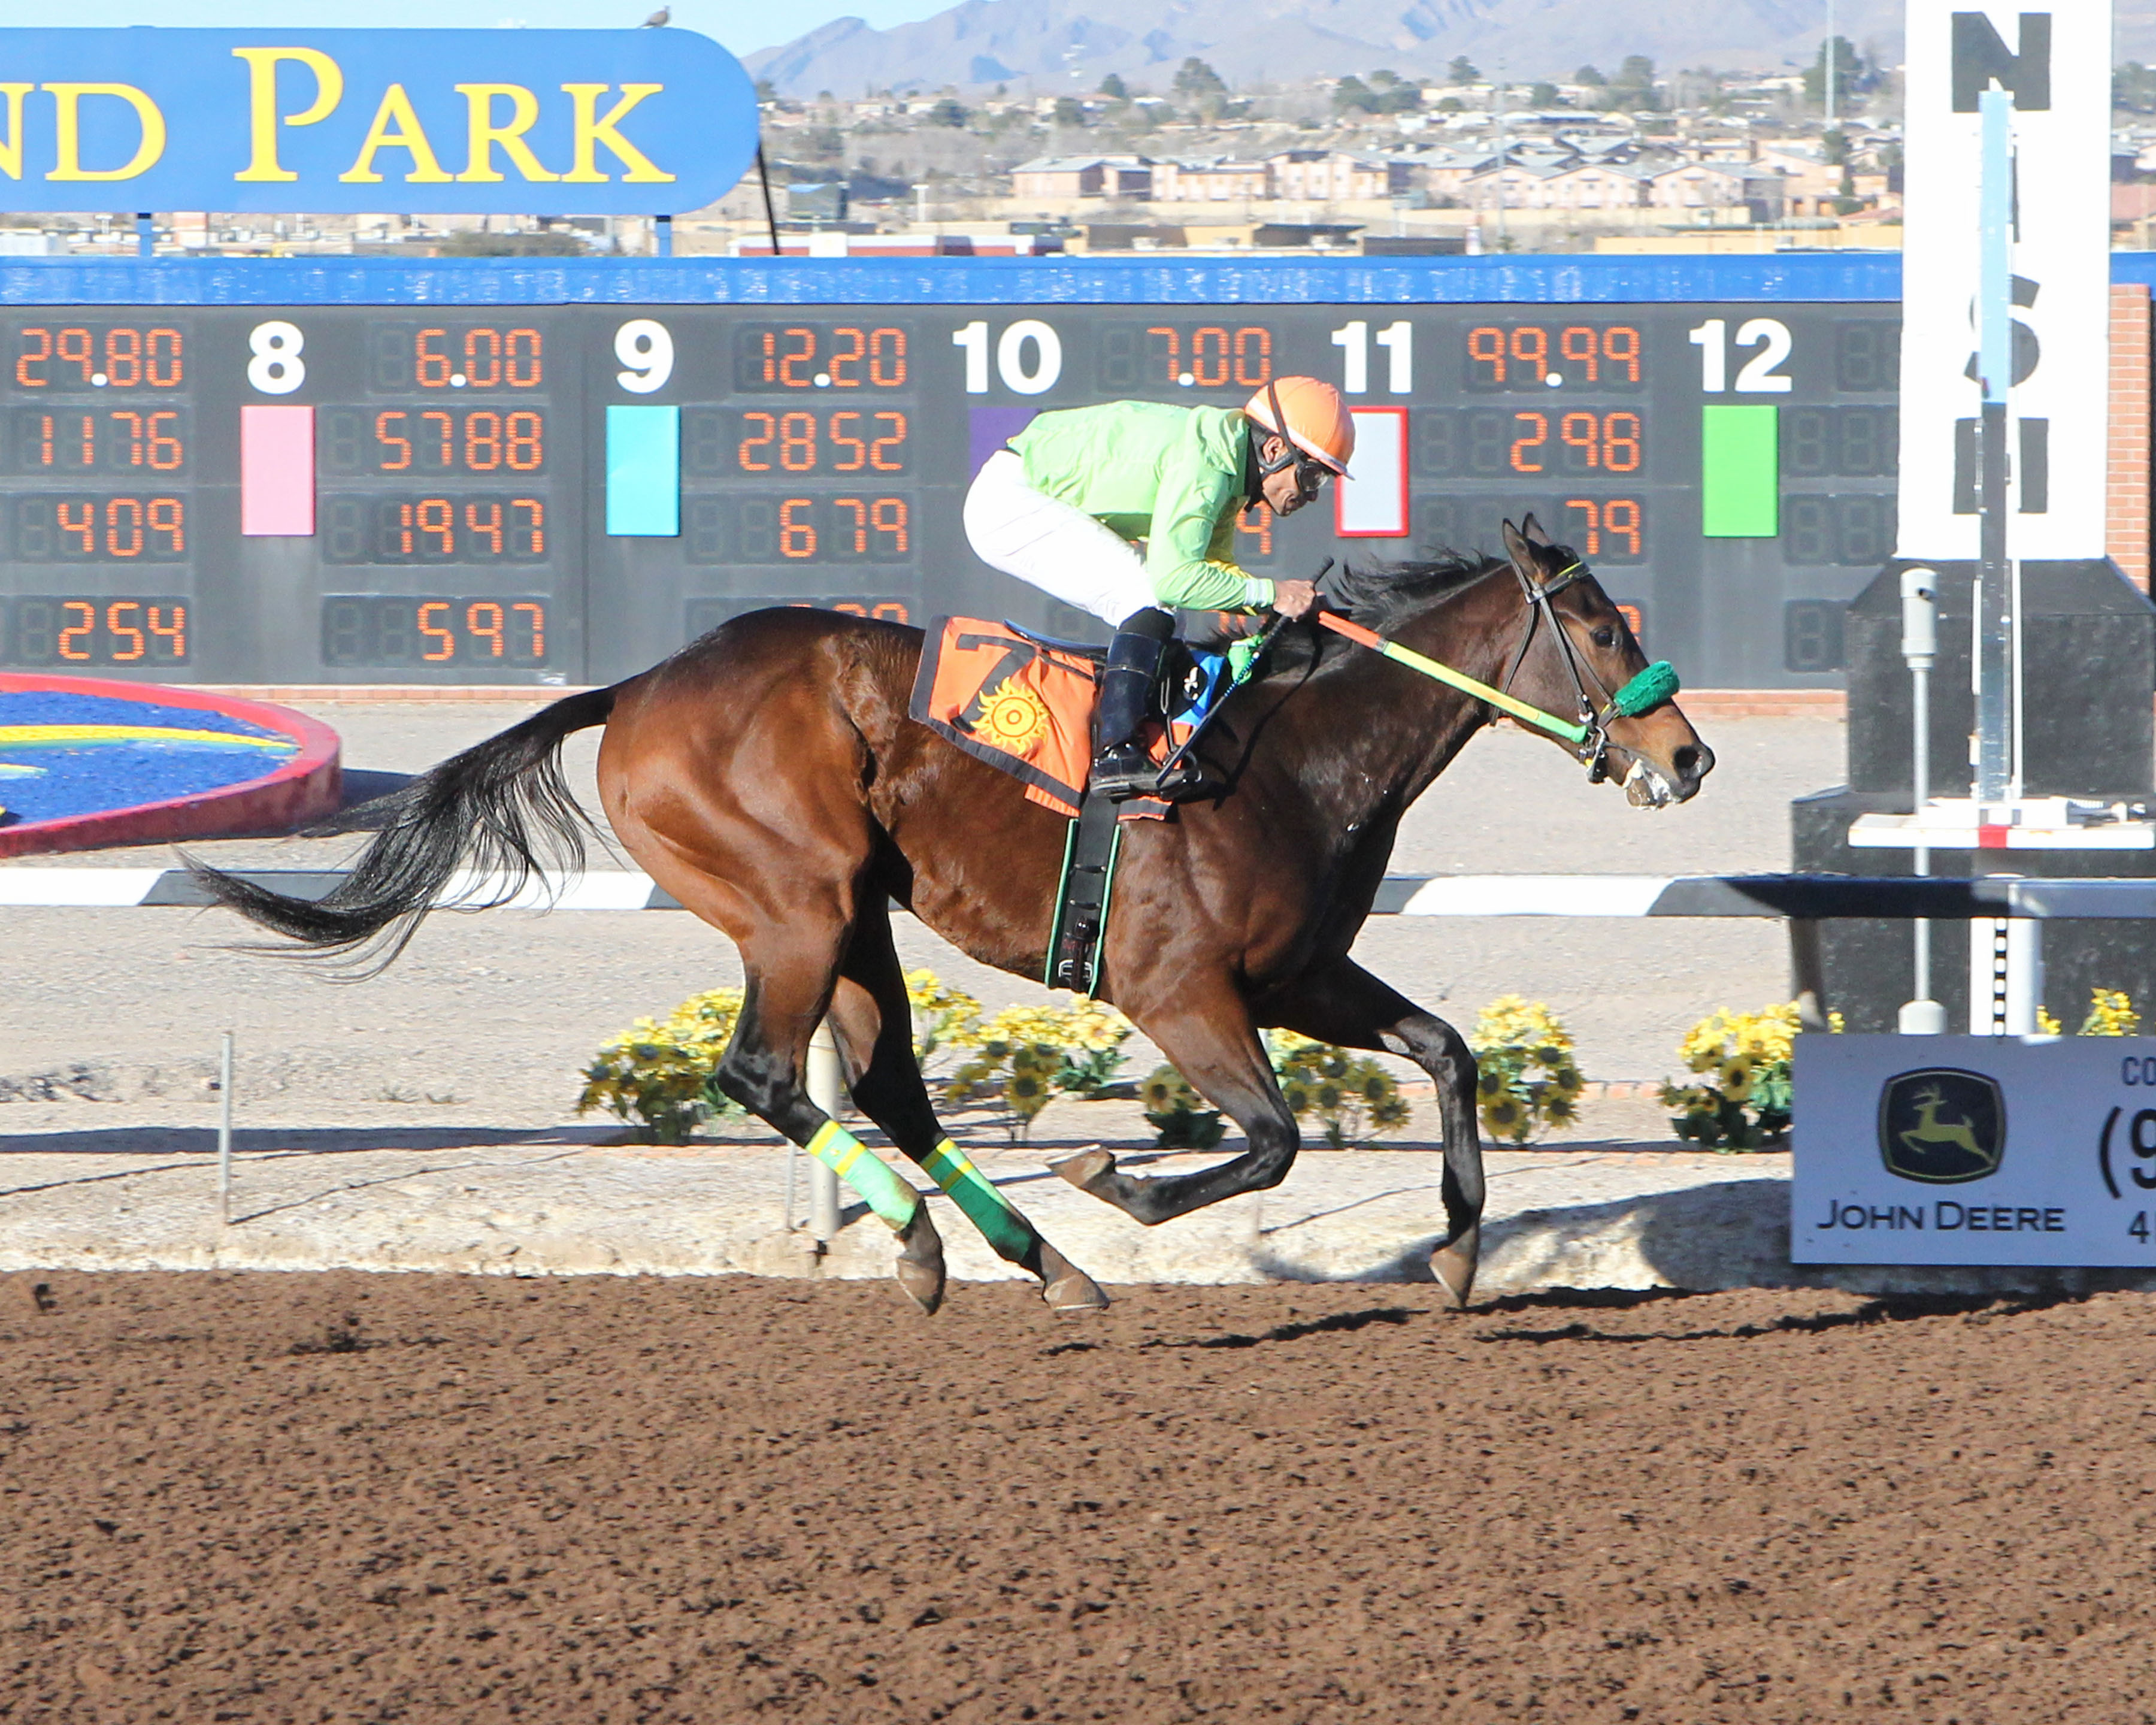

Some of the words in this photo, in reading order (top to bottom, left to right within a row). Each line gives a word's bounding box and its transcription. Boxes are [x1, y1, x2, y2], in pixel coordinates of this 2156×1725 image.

[232, 47, 676, 183] PARK
[16, 328, 183, 388] 29.80
[247, 320, 305, 394] 8
[416, 328, 543, 388] 6.00
[614, 319, 674, 393] 9
[762, 328, 907, 388] 12.20
[953, 320, 1062, 394] 10
[1146, 327, 1271, 386] 7.00
[1331, 321, 1412, 393] 11
[1468, 327, 1640, 388] 99.99
[1689, 319, 1792, 392] 12
[41, 412, 183, 470] 1176
[376, 411, 543, 470] 5788
[738, 412, 907, 471] 2852
[57, 498, 184, 556] 409
[401, 499, 544, 554] 1947
[780, 498, 908, 558] 679
[1565, 500, 1641, 555] 79
[58, 601, 185, 660] 254
[417, 603, 544, 661] 597
[1816, 1199, 1925, 1230] JOHN
[1935, 1200, 2067, 1232] DEERE
[2127, 1210, 2156, 1245] 4
